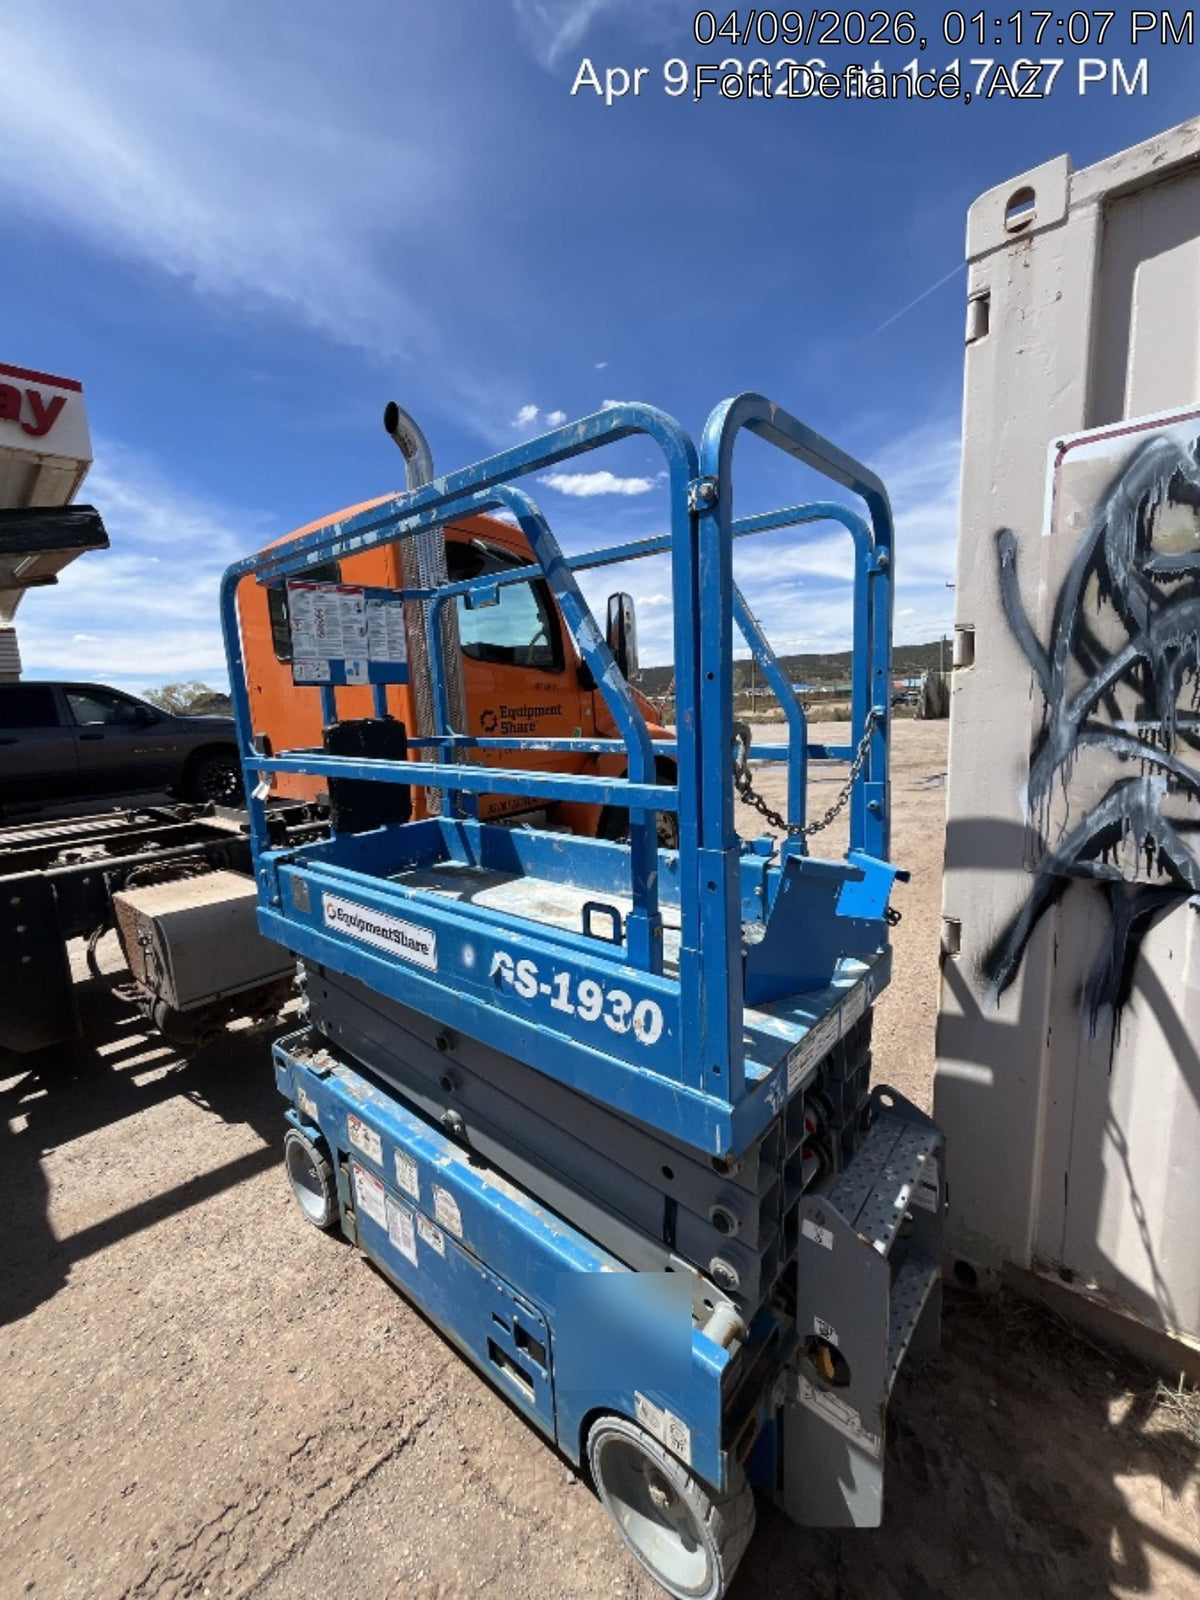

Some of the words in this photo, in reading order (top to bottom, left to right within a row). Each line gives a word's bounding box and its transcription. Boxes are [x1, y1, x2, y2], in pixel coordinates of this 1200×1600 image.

[499, 704, 563, 720] Equipment
[500, 721, 536, 734] Share
[336, 907, 430, 956] EquipmentShare
